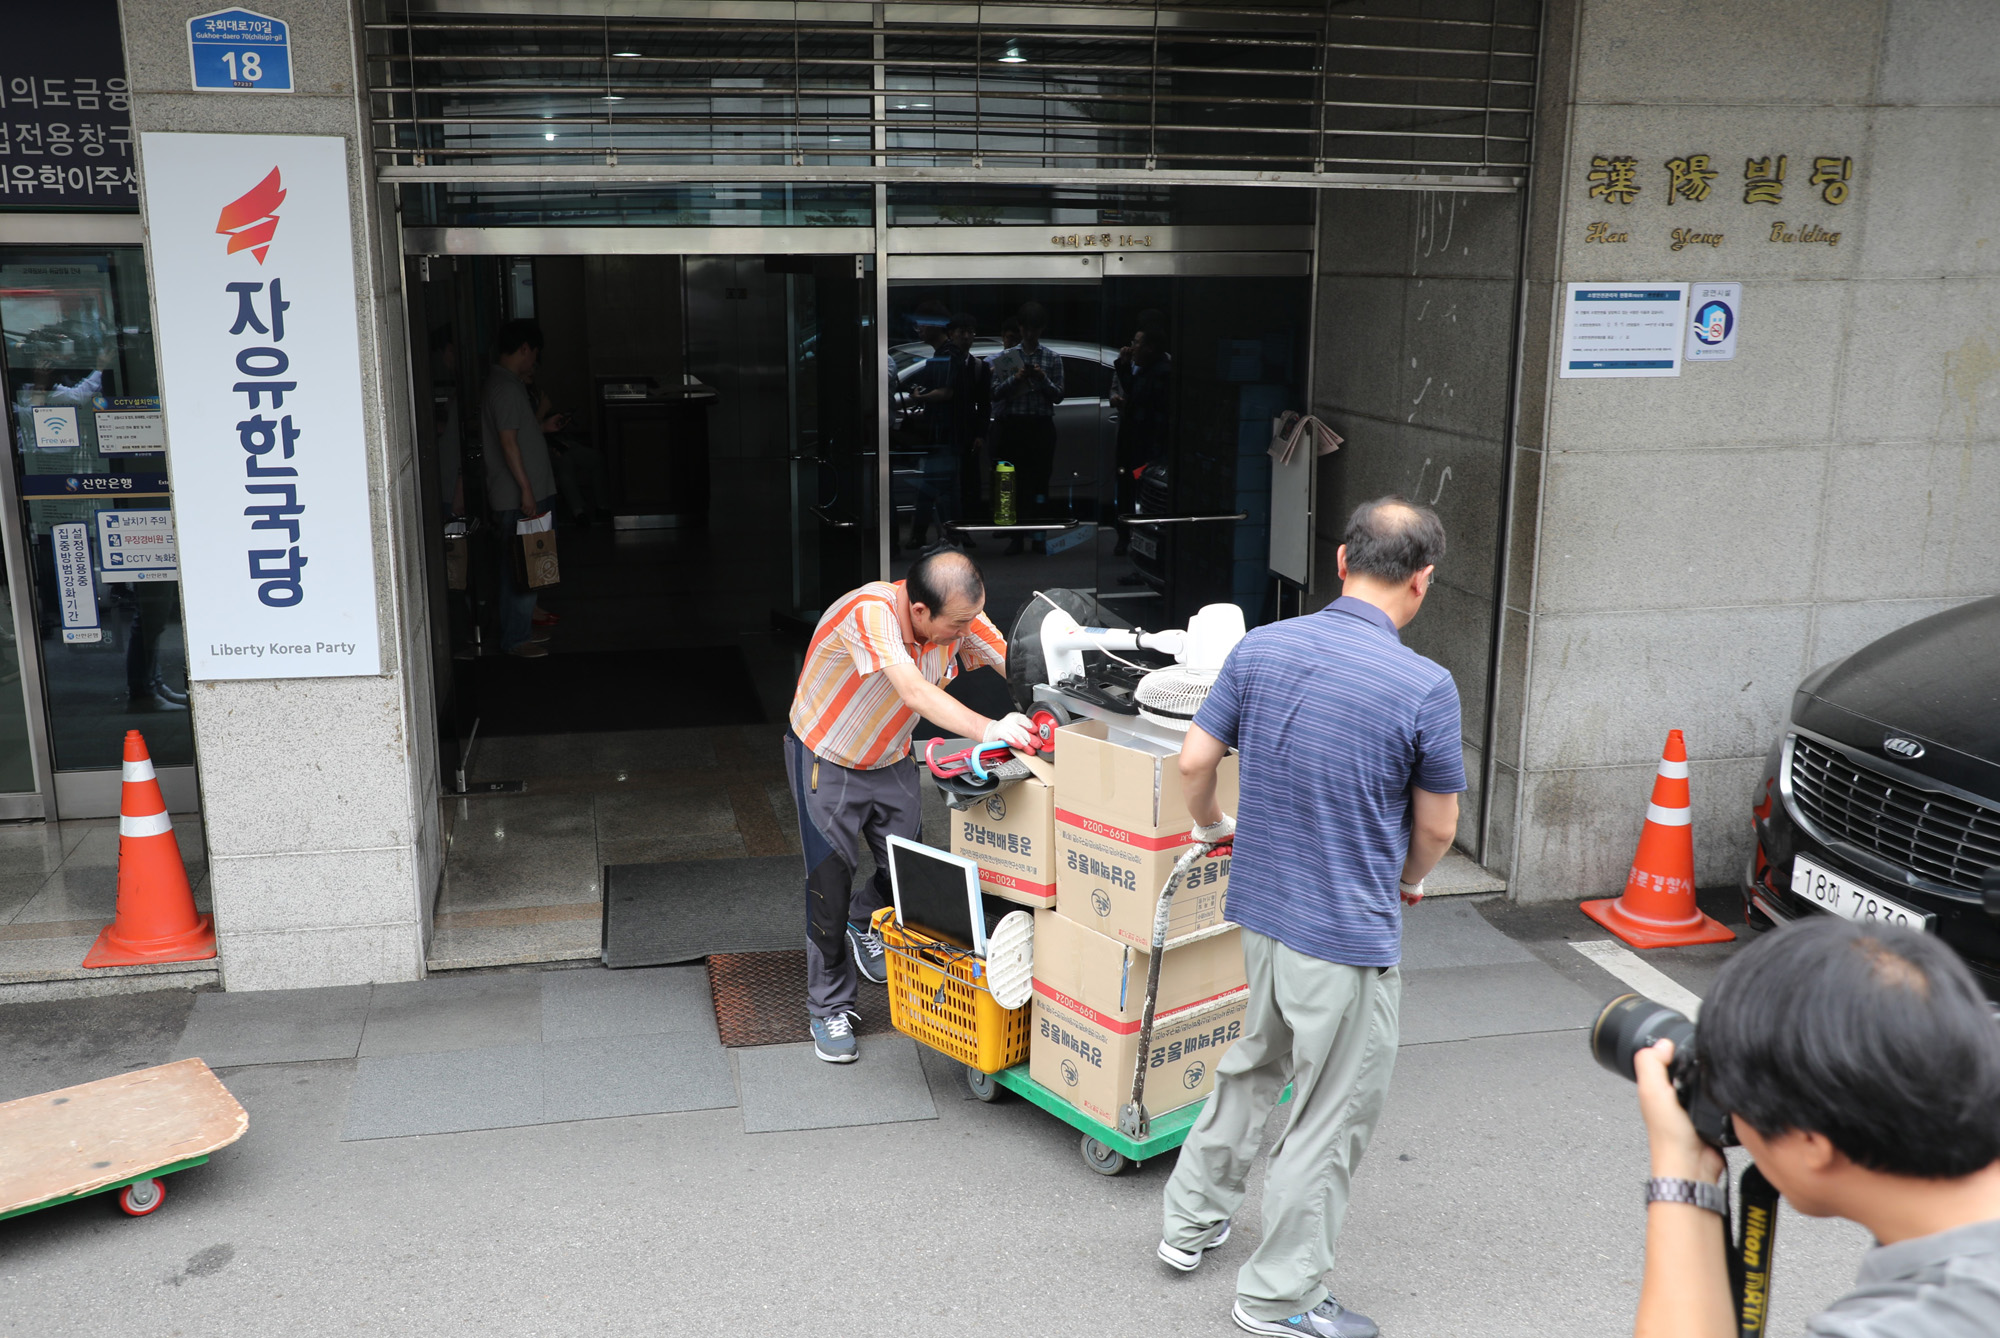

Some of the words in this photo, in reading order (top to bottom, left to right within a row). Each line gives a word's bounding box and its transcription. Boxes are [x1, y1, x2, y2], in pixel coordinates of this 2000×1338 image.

[195, 32, 240, 40] Gukhoe-daero
[205, 20, 272, 34] 국회대로70길
[221, 51, 263, 81] 18
[0, 75, 130, 111] 의도금융
[1119, 234, 1152, 247] 14-3
[1585, 221, 1629, 244] Han
[1770, 221, 1841, 247] Building
[225, 277, 308, 608] 자유한국당
[82, 478, 133, 489] 신한은행
[122, 516, 148, 527] 날치기
[150, 516, 167, 526] 주의
[124, 534, 164, 545] 무장경비원
[71, 527, 88, 587] 설정운용중
[126, 554, 152, 563] CCTV
[58, 528, 79, 622] 집중방범강화기간
[210, 643, 265, 658] Liberty
[269, 642, 312, 655] Korea
[316, 641, 356, 655] Party
[1887, 738, 1918, 757] KIA
[963, 822, 1032, 857] 강남택배통운
[1083, 819, 1130, 842] 1599-0024
[978, 869, 1016, 888] 99-0024
[1067, 849, 1136, 892] 강남택배통운
[1804, 868, 1841, 908] 18하
[1055, 992, 1098, 1022] 1599-0024
[1040, 1017, 1102, 1068] 강남택배통운
[1150, 1020, 1241, 1068] 강남택배통운
[1743, 1205, 1767, 1267] Nikon
